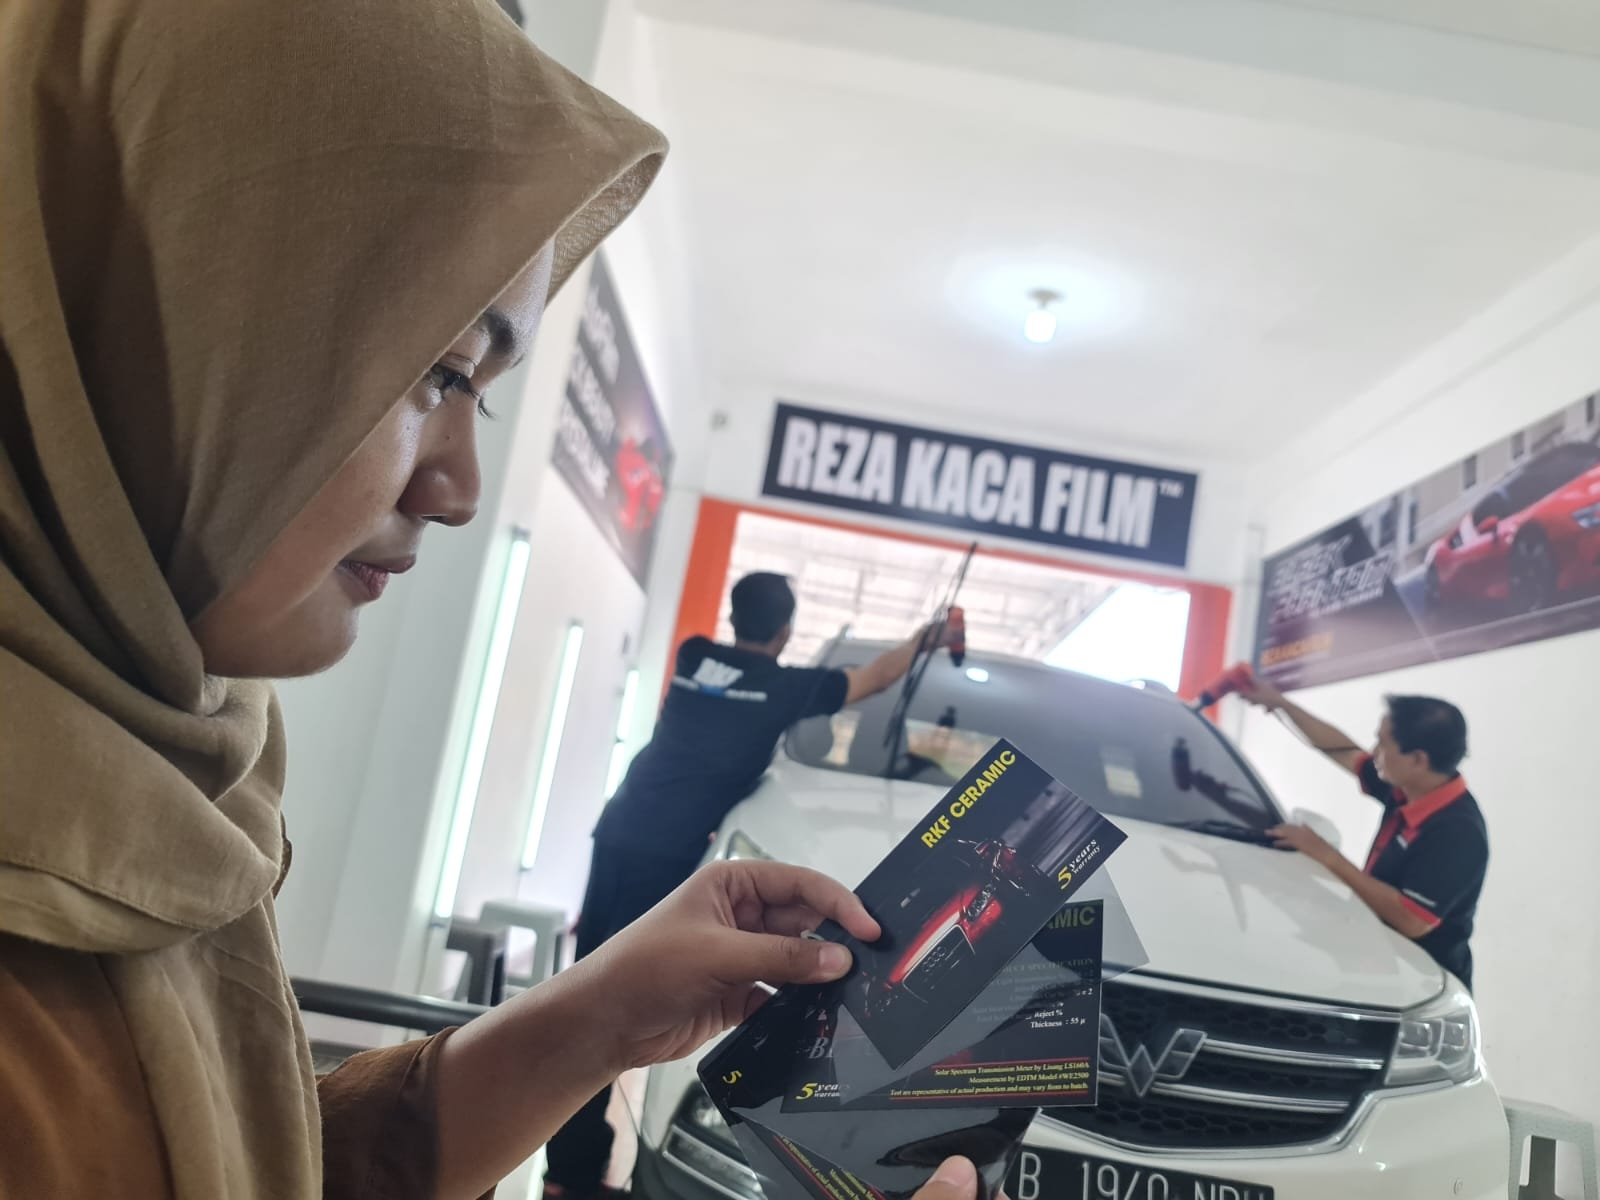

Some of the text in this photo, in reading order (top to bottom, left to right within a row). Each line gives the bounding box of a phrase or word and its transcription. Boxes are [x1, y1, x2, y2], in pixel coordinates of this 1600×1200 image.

[776, 414, 899, 505] REZA
[901, 436, 1036, 528] KACA
[921, 750, 1016, 849] RKF CERAMIC
[1058, 839, 1097, 890] 5 years
[1030, 1019, 1063, 1029] Thickness
[795, 1082, 819, 1100] 5
[1017, 1151, 1042, 1200] B
